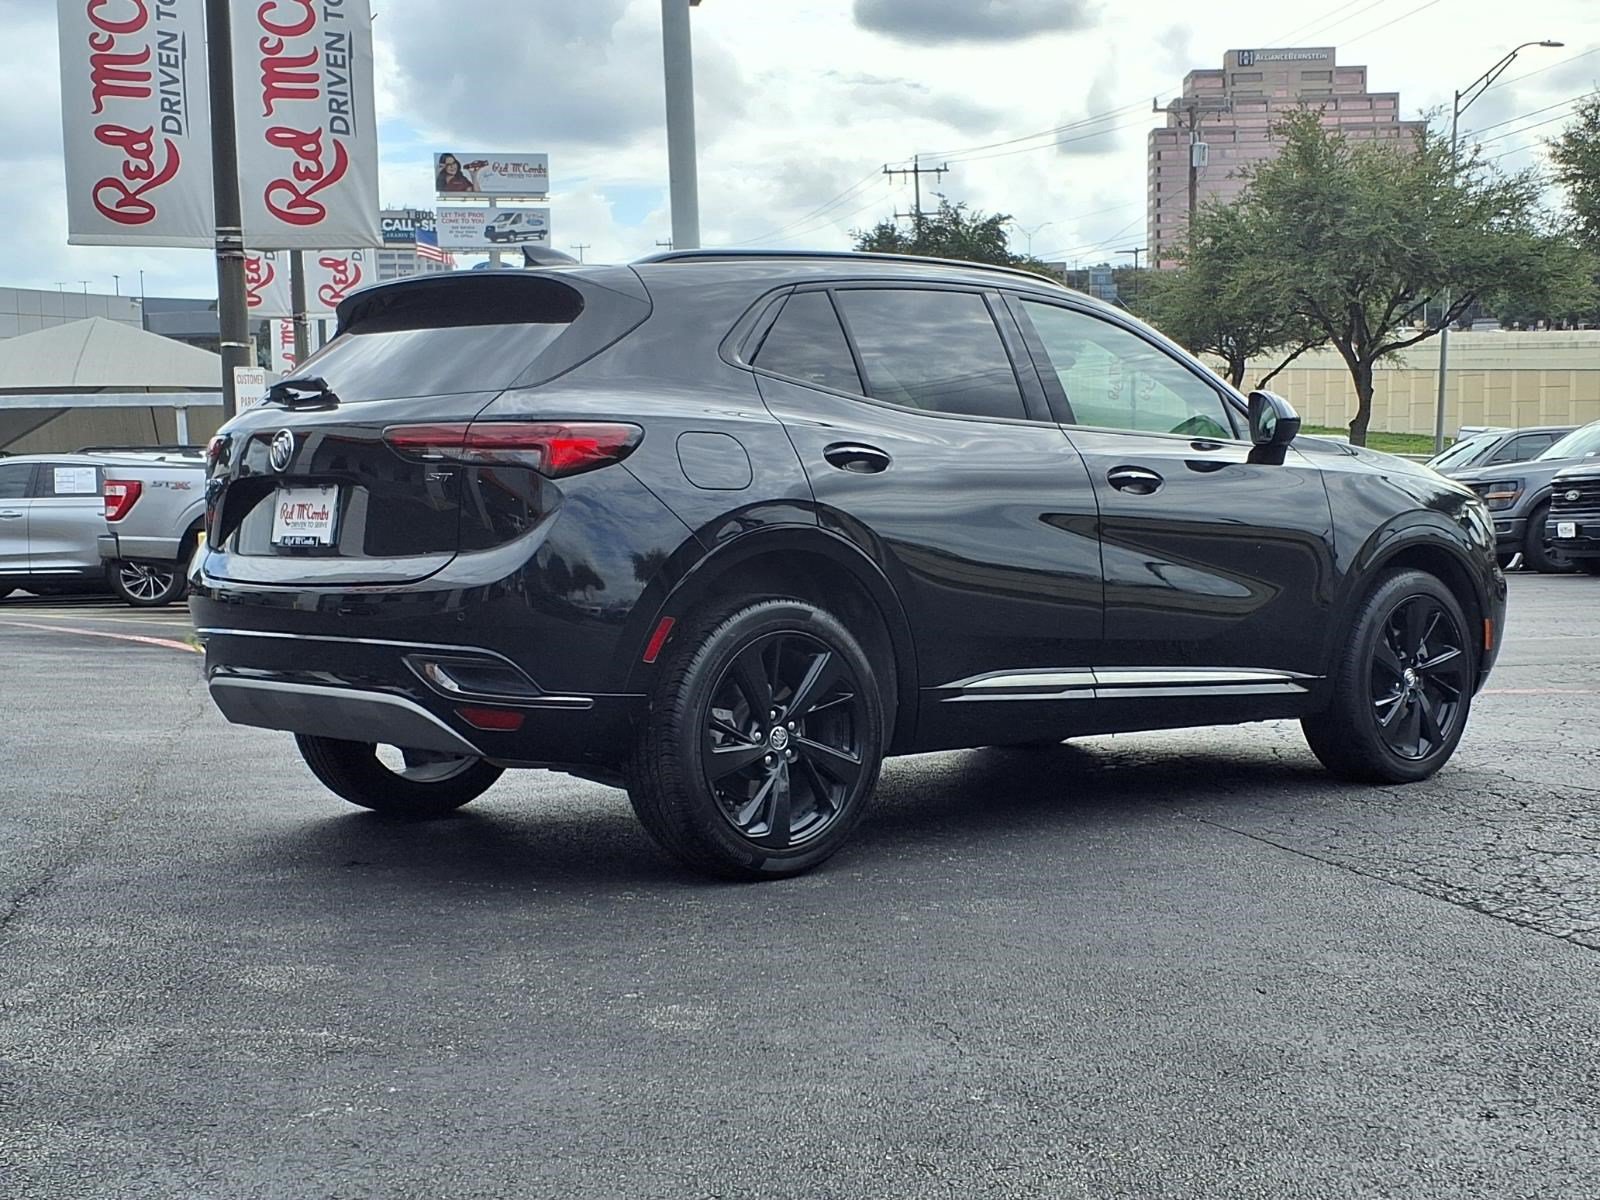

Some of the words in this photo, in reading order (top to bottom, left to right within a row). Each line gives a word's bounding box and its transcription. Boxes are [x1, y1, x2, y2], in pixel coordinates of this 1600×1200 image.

[156, 30, 183, 136] DRIVEN
[324, 32, 350, 137] DRIVEN
[92, 124, 181, 225] Red
[264, 126, 348, 226] Red
[318, 257, 361, 307] Red
[236, 374, 264, 385] CUSTOMER
[280, 502, 295, 526] Red
[296, 502, 329, 521] McCombs
